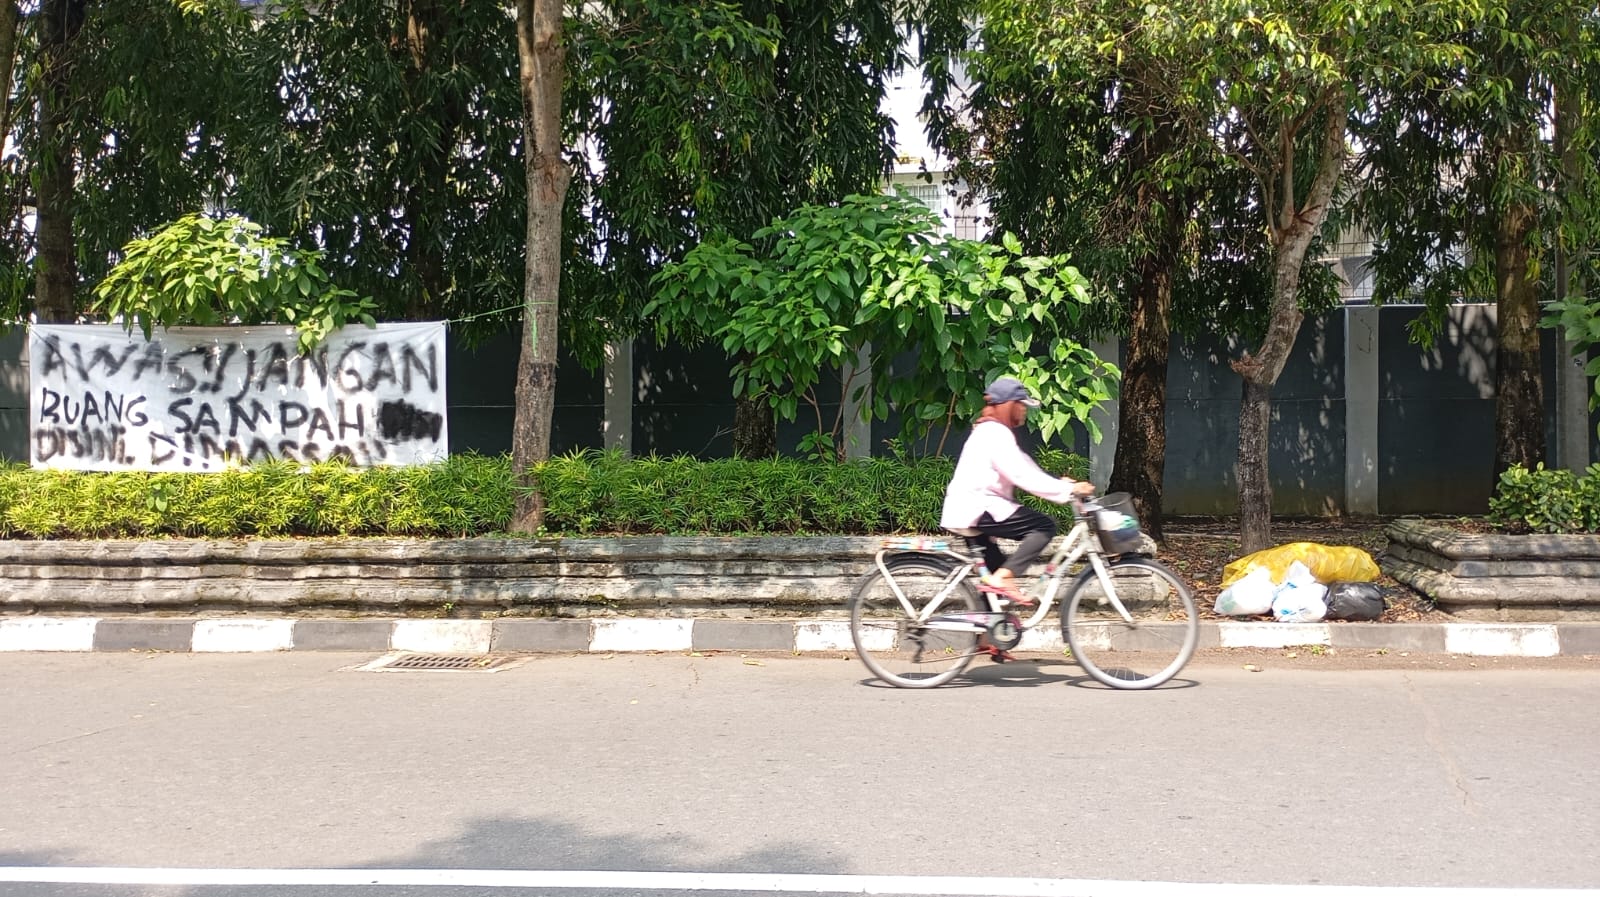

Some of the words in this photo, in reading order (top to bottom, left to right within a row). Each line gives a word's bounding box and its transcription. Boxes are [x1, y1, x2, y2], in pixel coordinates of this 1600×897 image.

[229, 340, 438, 402] JANGAN
[41, 387, 149, 427] BUANG
[168, 396, 365, 441] SAMPAH
